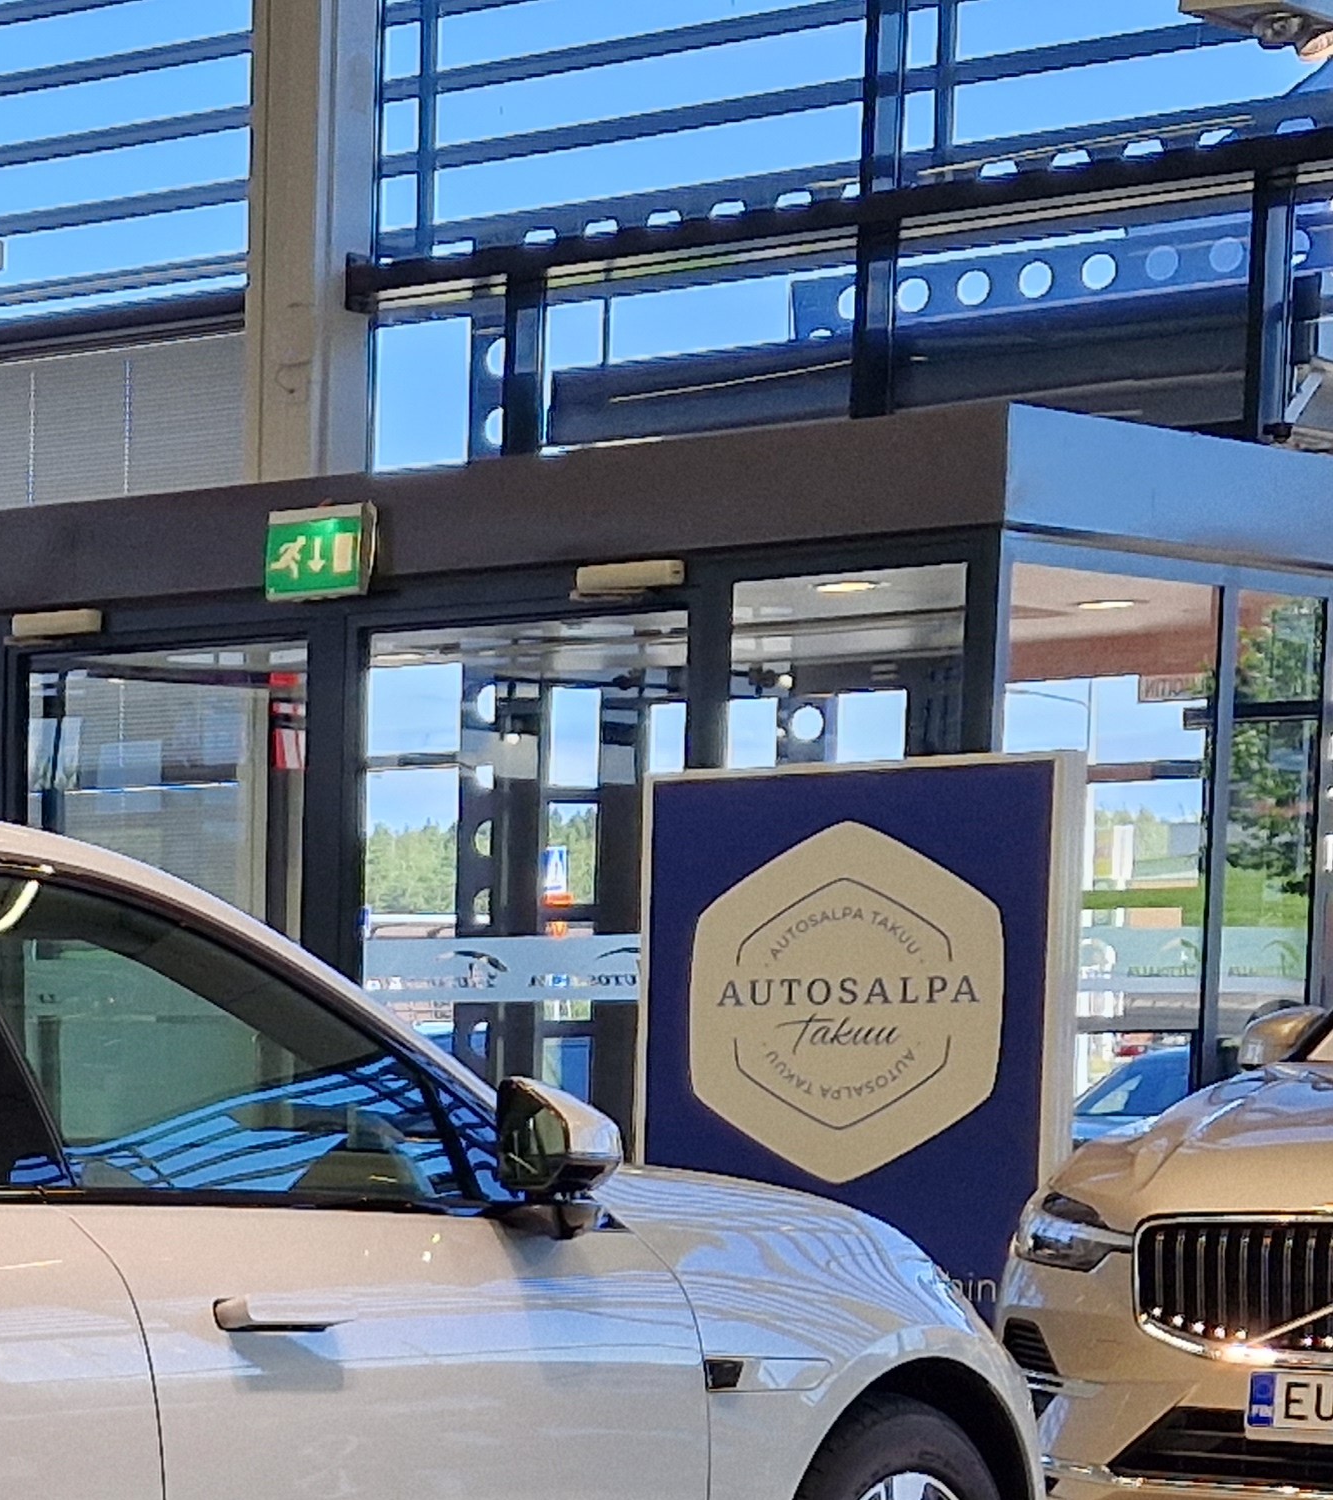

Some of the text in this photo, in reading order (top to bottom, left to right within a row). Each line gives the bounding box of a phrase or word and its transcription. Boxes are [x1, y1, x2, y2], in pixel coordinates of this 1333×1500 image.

[770, 906, 921, 960] AUTOSALPA TAKUU
[717, 975, 980, 1007] AUTOSALPA
[776, 1013, 900, 1055] Takuu
[766, 1048, 915, 1099] AUTOSALPA TAKUU
